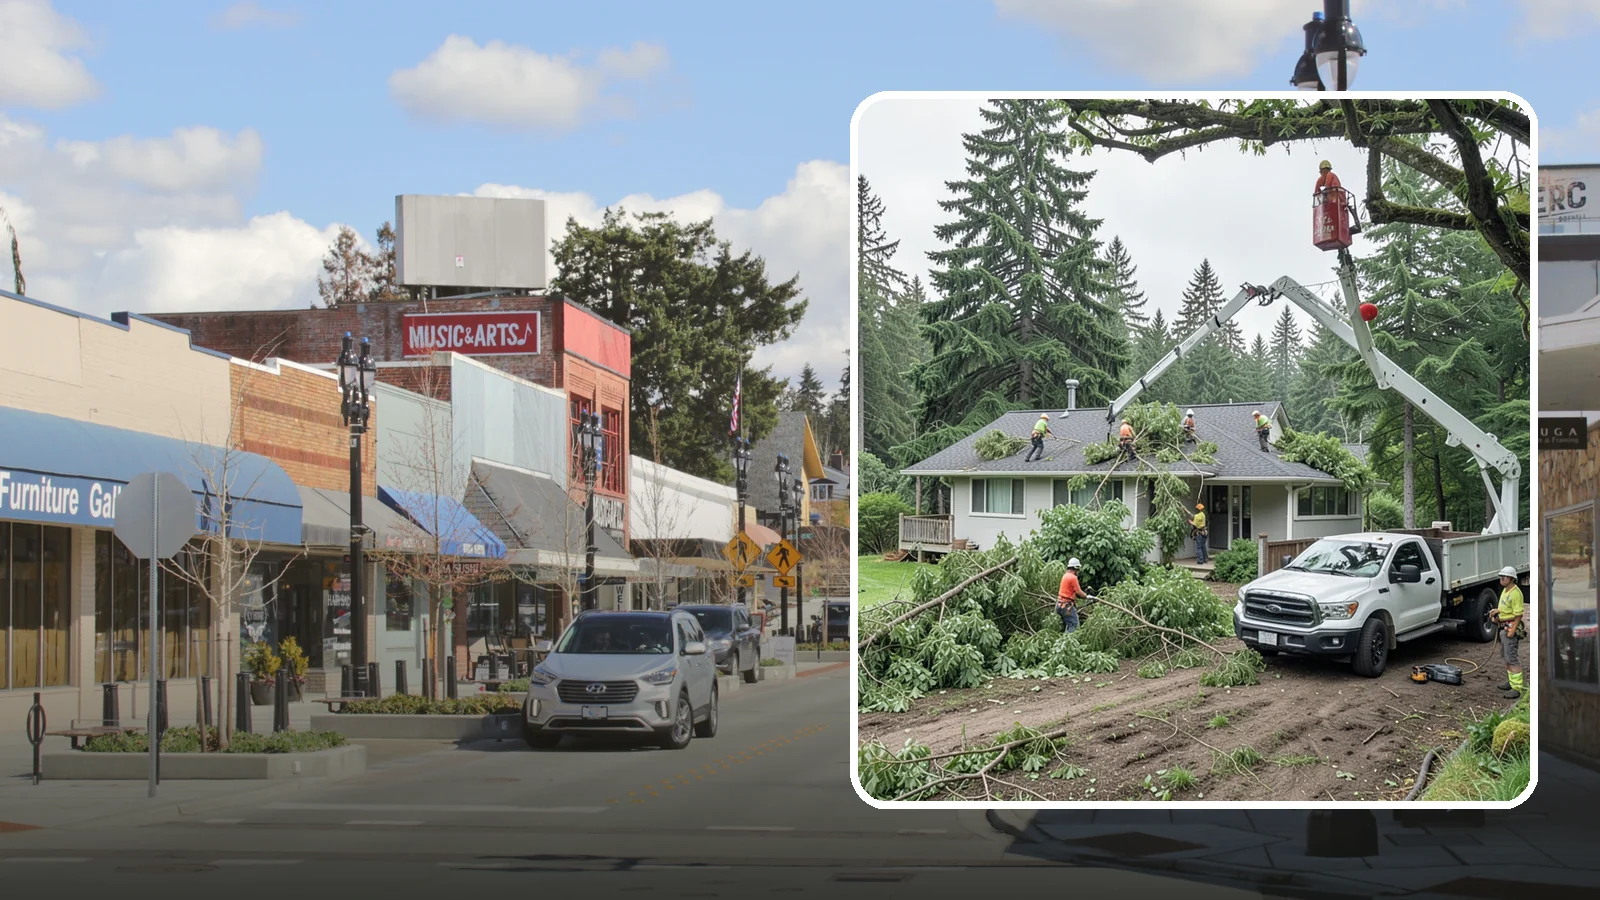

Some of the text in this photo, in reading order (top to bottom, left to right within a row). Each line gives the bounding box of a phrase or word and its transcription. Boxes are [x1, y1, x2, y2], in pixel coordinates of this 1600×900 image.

[408, 323, 520, 349] MUSIC&ARTS
[0, 471, 122, 519] Furniture Gal
[453, 562, 480, 574] SUSHI
